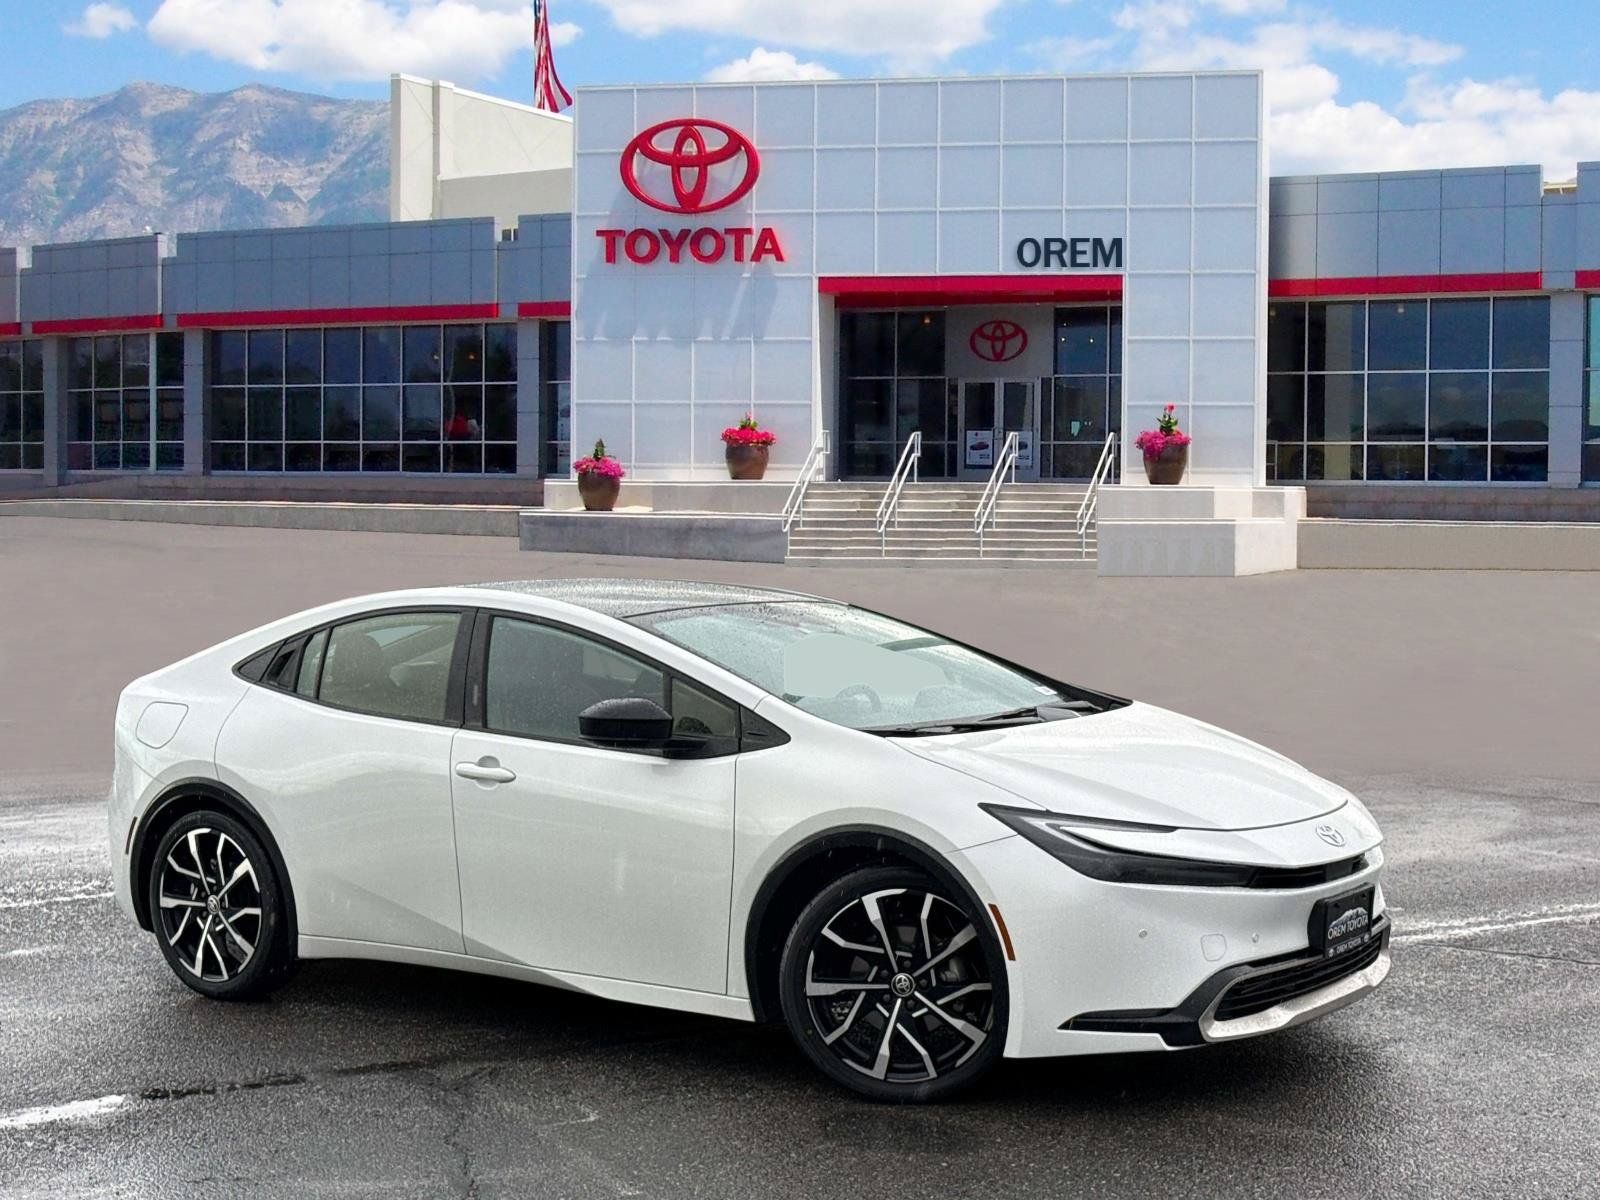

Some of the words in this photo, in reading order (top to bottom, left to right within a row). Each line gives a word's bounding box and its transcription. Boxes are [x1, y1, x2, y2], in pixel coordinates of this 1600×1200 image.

[596, 227, 784, 264] TOYOTA
[1017, 237, 1122, 268] OREM
[1327, 922, 1347, 940] OREM
[1347, 914, 1368, 933] TOYOTA
